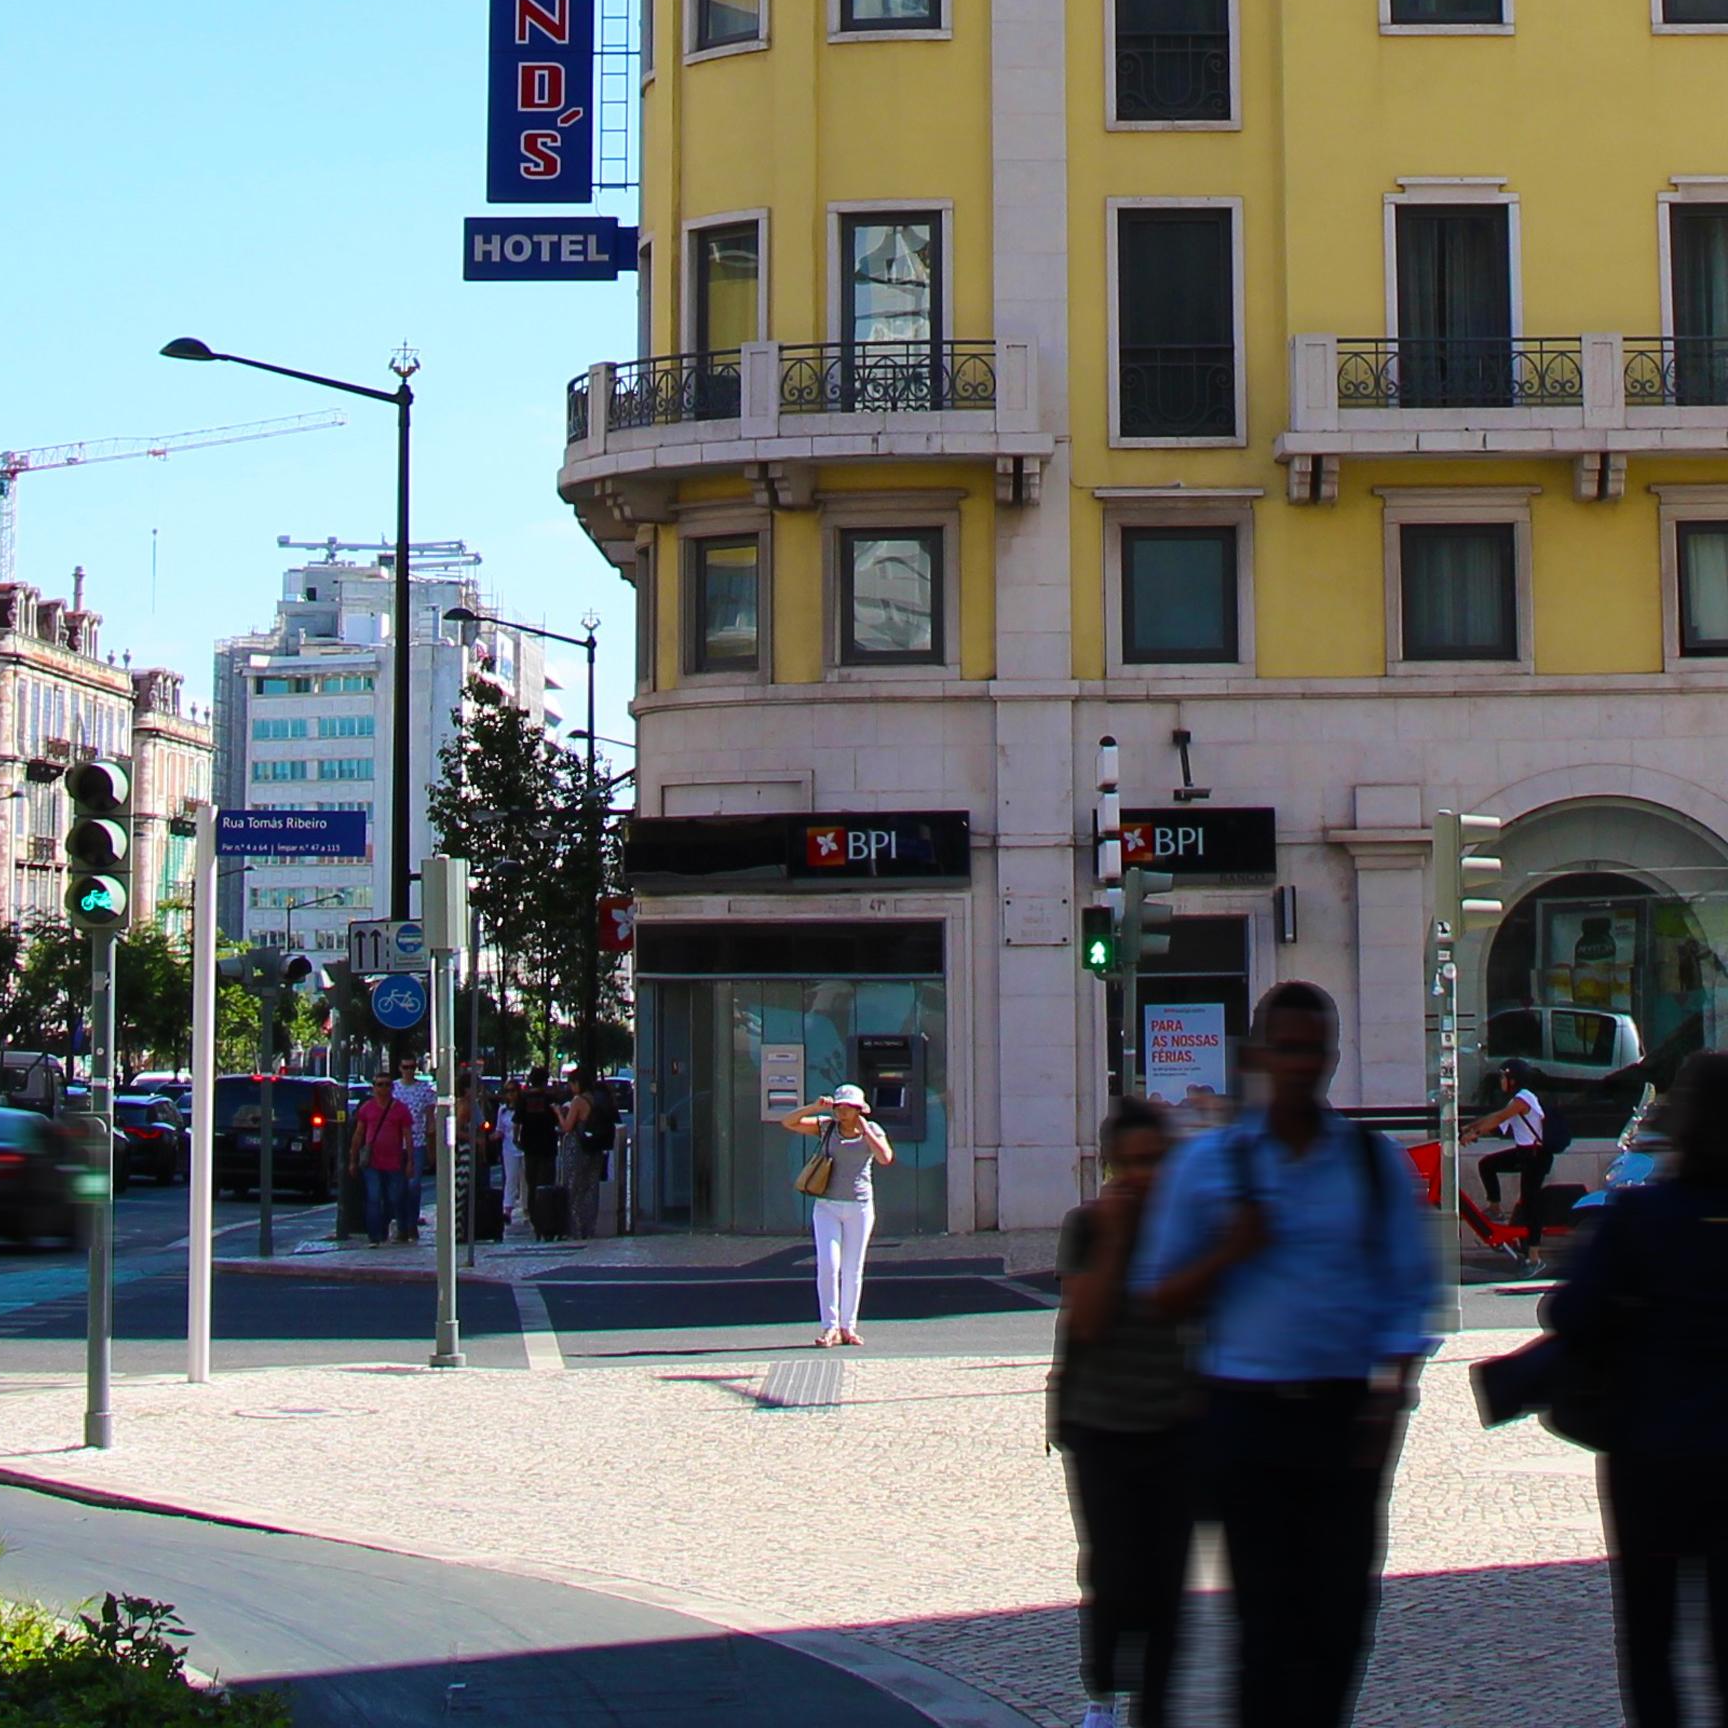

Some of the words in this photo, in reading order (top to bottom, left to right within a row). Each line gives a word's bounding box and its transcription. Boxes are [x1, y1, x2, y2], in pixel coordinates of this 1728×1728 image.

[473, 233, 610, 264] HOTEL
[223, 817, 244, 829] Rua
[247, 816, 283, 829] Tomás
[286, 816, 327, 829] Ribeiro
[848, 831, 896, 860] BPI
[1155, 827, 1204, 856] BPI
[1151, 1019, 1183, 1032] PARA
[1152, 1035, 1168, 1048] AS
[1171, 1034, 1218, 1047] NOSSAS
[1152, 1048, 1196, 1063] FÉRIAS.
